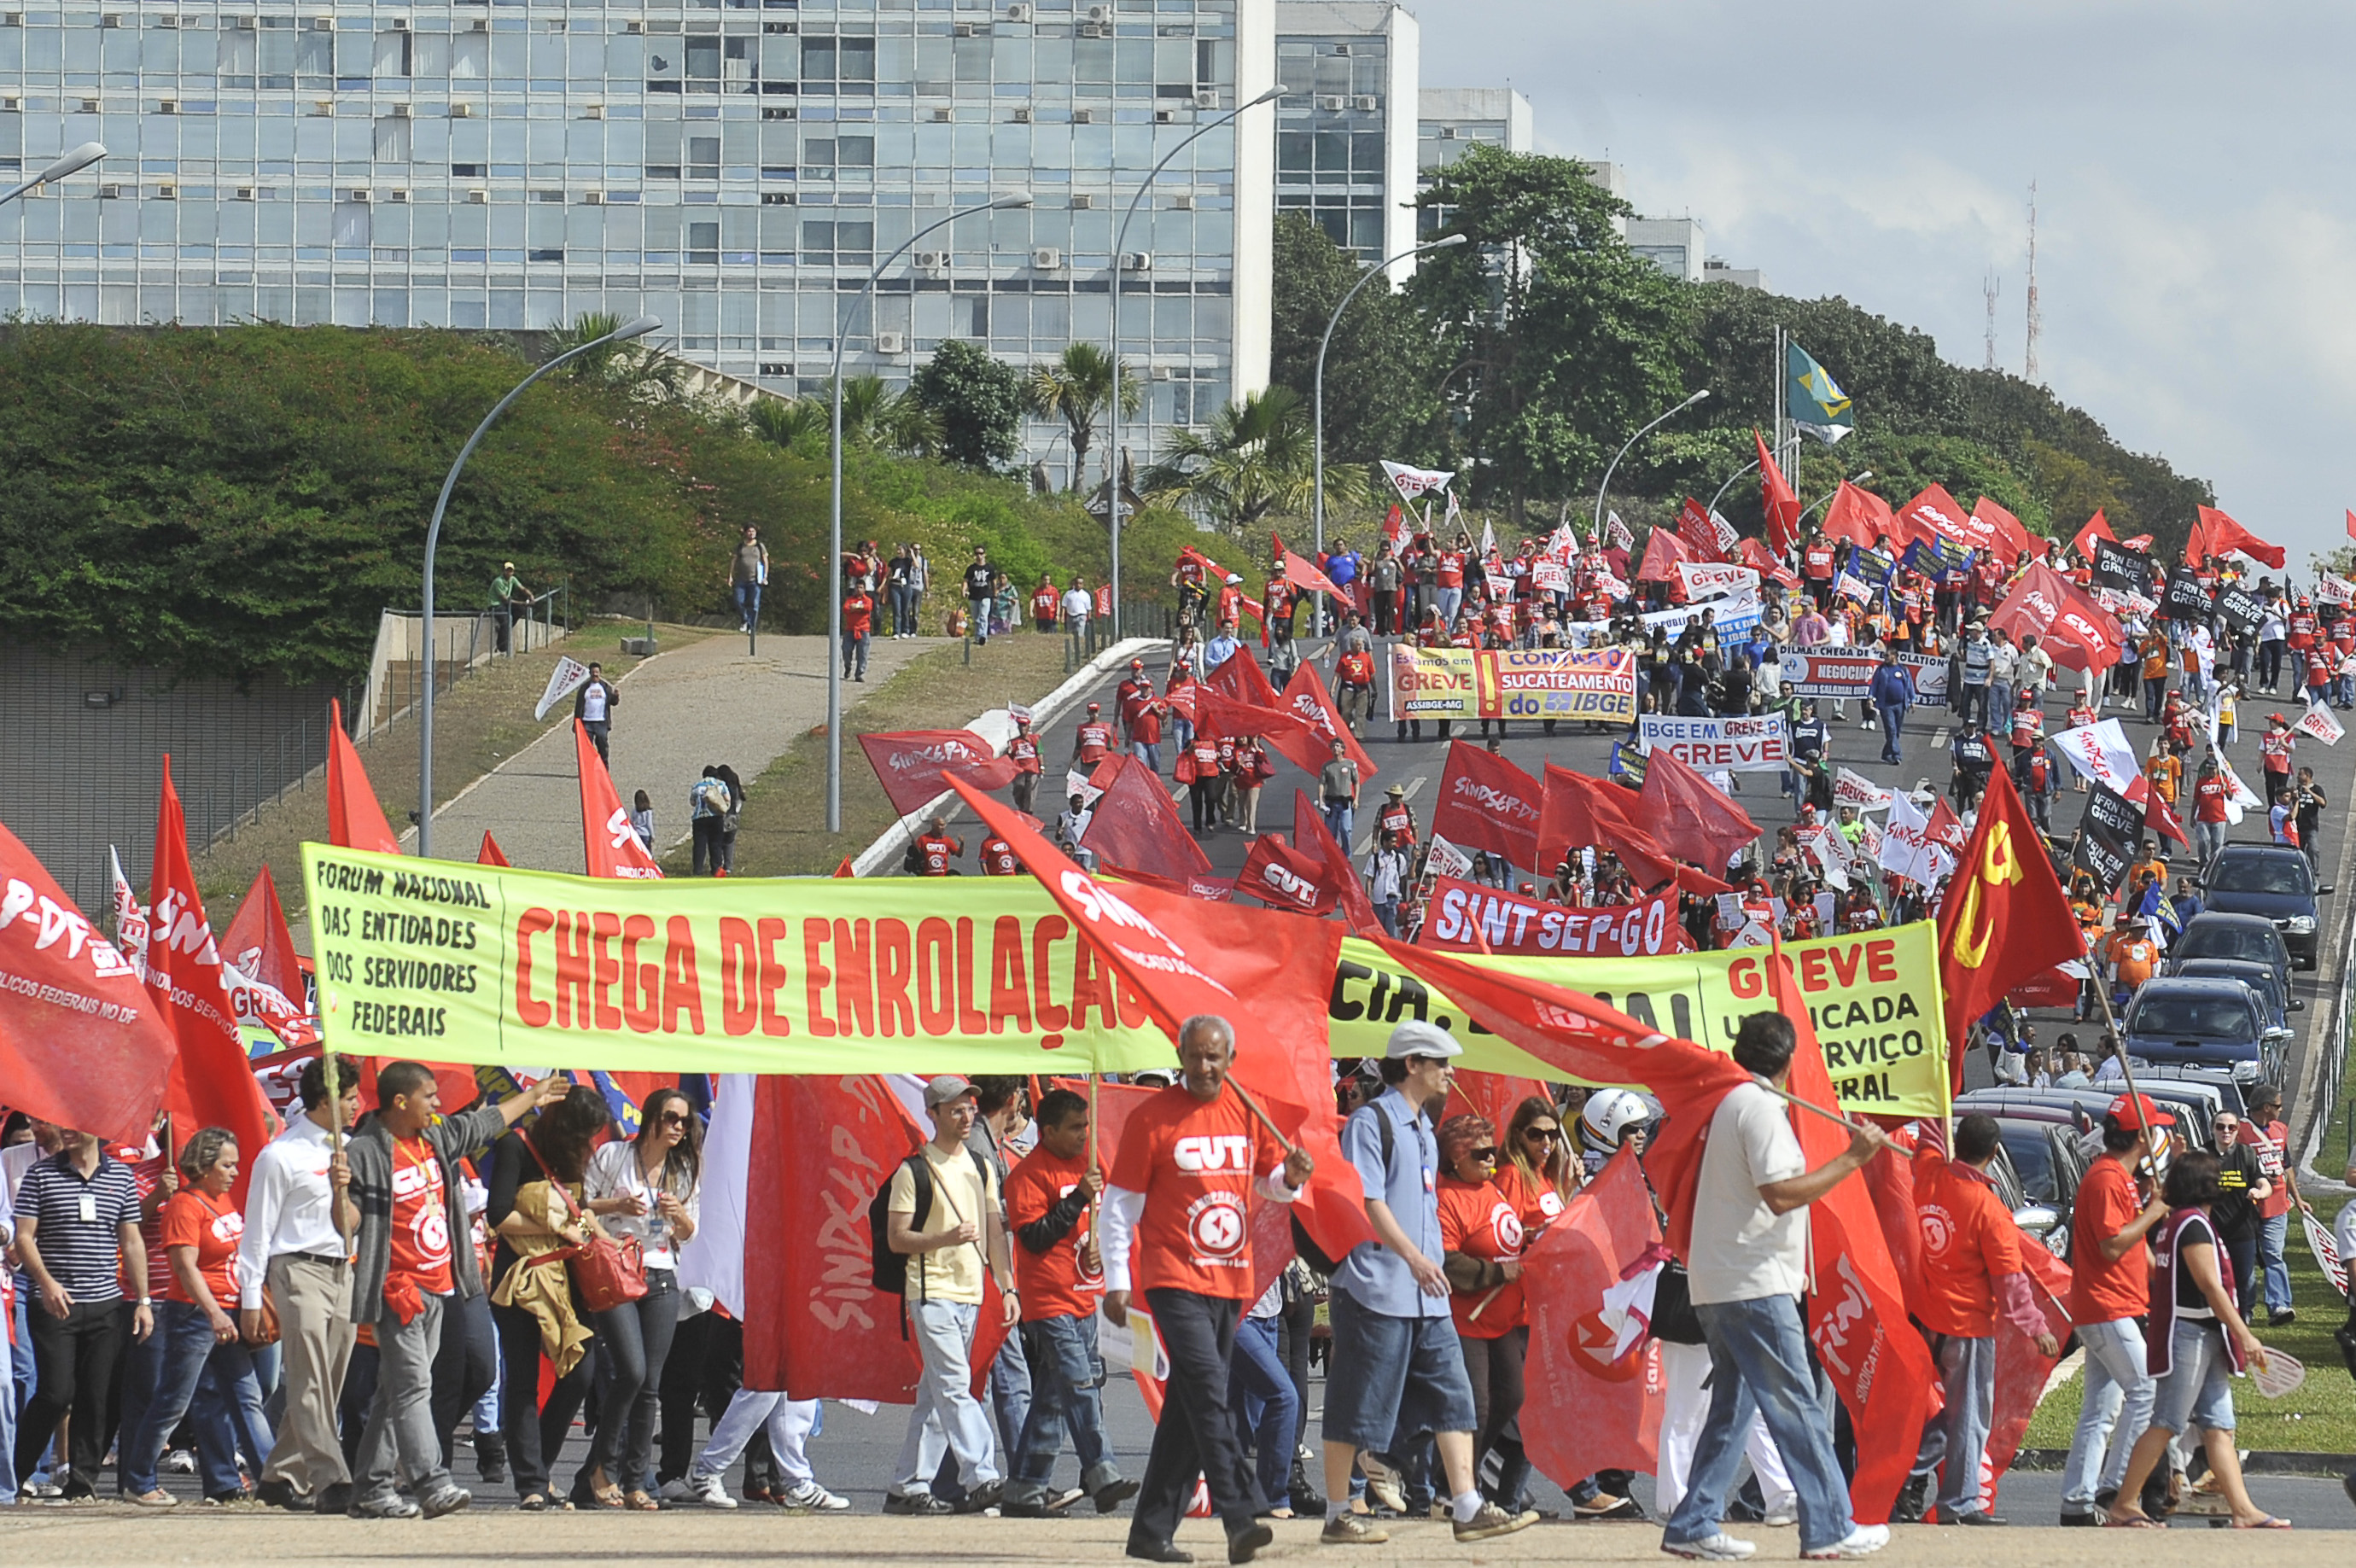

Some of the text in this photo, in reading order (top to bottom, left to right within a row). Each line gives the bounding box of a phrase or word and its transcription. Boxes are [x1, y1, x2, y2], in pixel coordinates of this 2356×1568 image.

[1692, 568, 1747, 586] GREVE
[2101, 559, 2140, 583] GREVE
[2171, 591, 2212, 613] GREVE
[2223, 597, 2263, 623] GREVE
[1397, 653, 1472, 667] Estamos em
[1509, 649, 1620, 667] CONTRA O
[1820, 647, 1853, 656] CHEGA
[1397, 673, 1472, 692] GREVE
[1502, 673, 1632, 693] SUCATEAMENTO
[1406, 699, 1463, 711] ASSIBGE-MG
[1509, 692, 1630, 715] do IBGE
[1642, 722, 1685, 739] IBGE
[1691, 724, 1718, 739] EM
[1725, 720, 1764, 737] GREVE
[2304, 713, 2338, 740] GREVE
[1669, 739, 1784, 765] GREVE
[2094, 792, 2118, 813] IFRN
[2091, 804, 2134, 835] GREVE
[2106, 854, 2124, 872] EM
[318, 860, 491, 909] FORUM NACIONAL
[1264, 863, 1315, 902] CUT
[0, 877, 90, 959] P-DF
[322, 904, 477, 950] DAS ENTIDADES
[326, 950, 477, 994] DOS SERVIDORES
[516, 906, 705, 1035] CHEGA
[720, 916, 790, 1037] DE
[1728, 939, 1898, 999] GREVE
[38, 984, 101, 1015] FEDERAIS
[98, 1002, 120, 1021] NO
[118, 1007, 138, 1025] DF
[169, 987, 195, 1009] DOS
[353, 1000, 446, 1037] FEDERAIS
[1174, 1135, 1249, 1171] CUT
